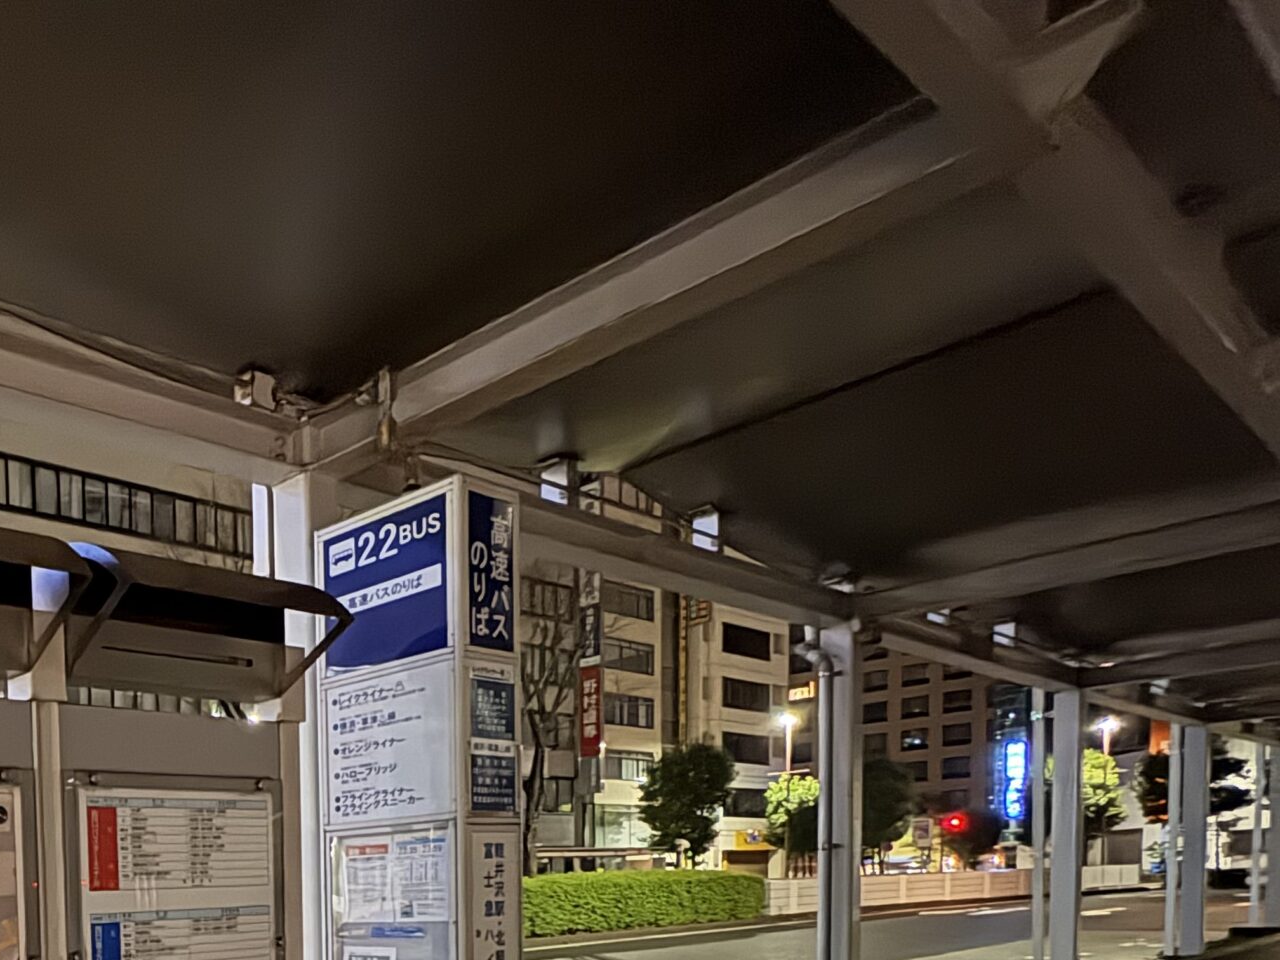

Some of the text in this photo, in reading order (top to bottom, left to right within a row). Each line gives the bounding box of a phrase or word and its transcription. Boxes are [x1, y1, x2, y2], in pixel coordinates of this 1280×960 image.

[471, 540, 489, 637] のりば
[490, 513, 510, 641] 高速バス
